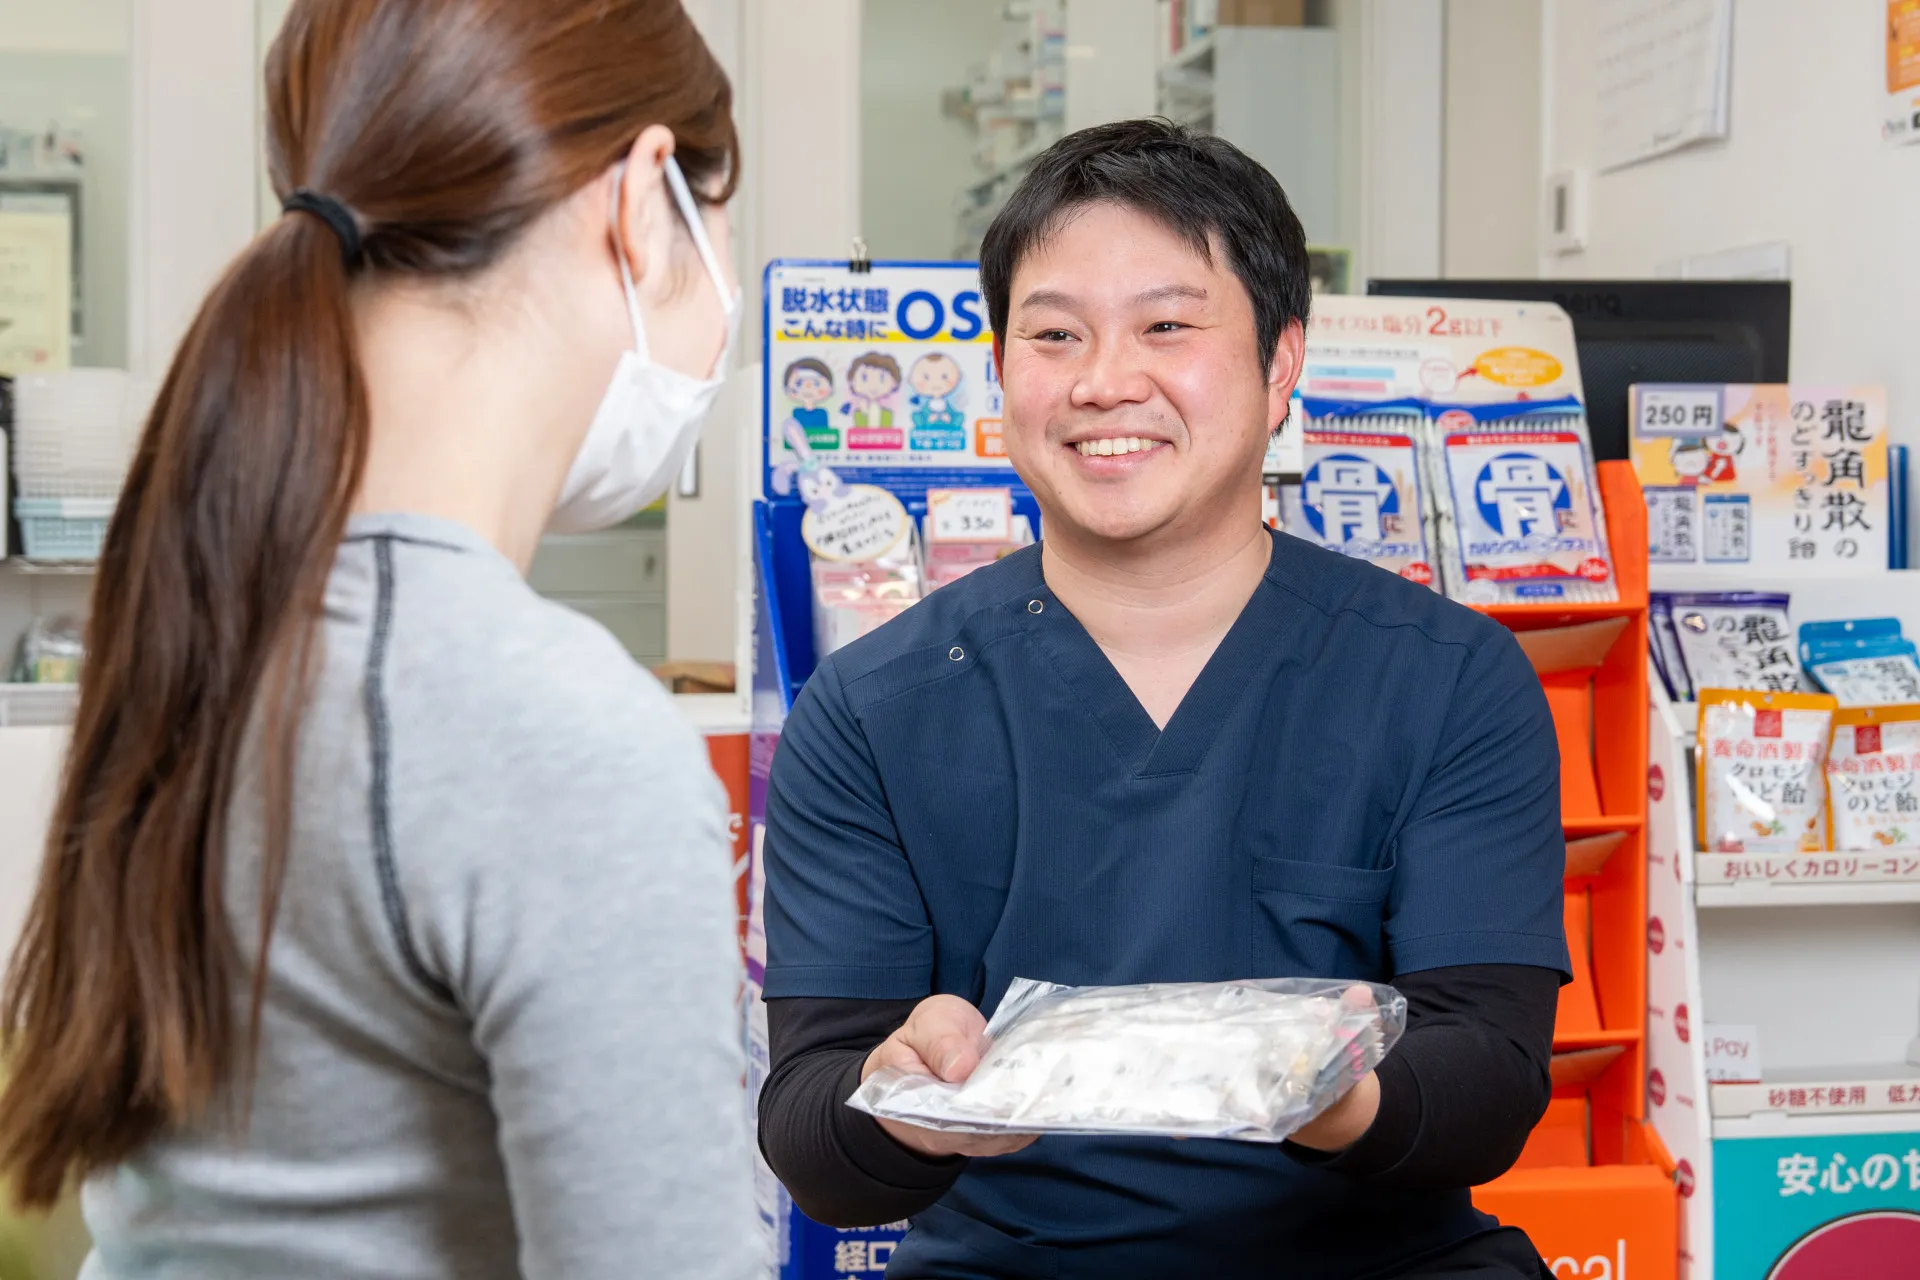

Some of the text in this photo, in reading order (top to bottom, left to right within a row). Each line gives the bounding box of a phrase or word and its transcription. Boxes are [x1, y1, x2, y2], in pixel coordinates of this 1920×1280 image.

[782, 287, 888, 313] 脱水状態
[783, 319, 887, 340] こんな時に
[1788, 401, 1817, 560] のどすっきり飴
[1820, 399, 1873, 559] 龍角散の
[1847, 792, 1918, 812] のど飴
[1768, 1085, 1866, 1108] 砂糖不使用
[1543, 1238, 1626, 1280] cal
